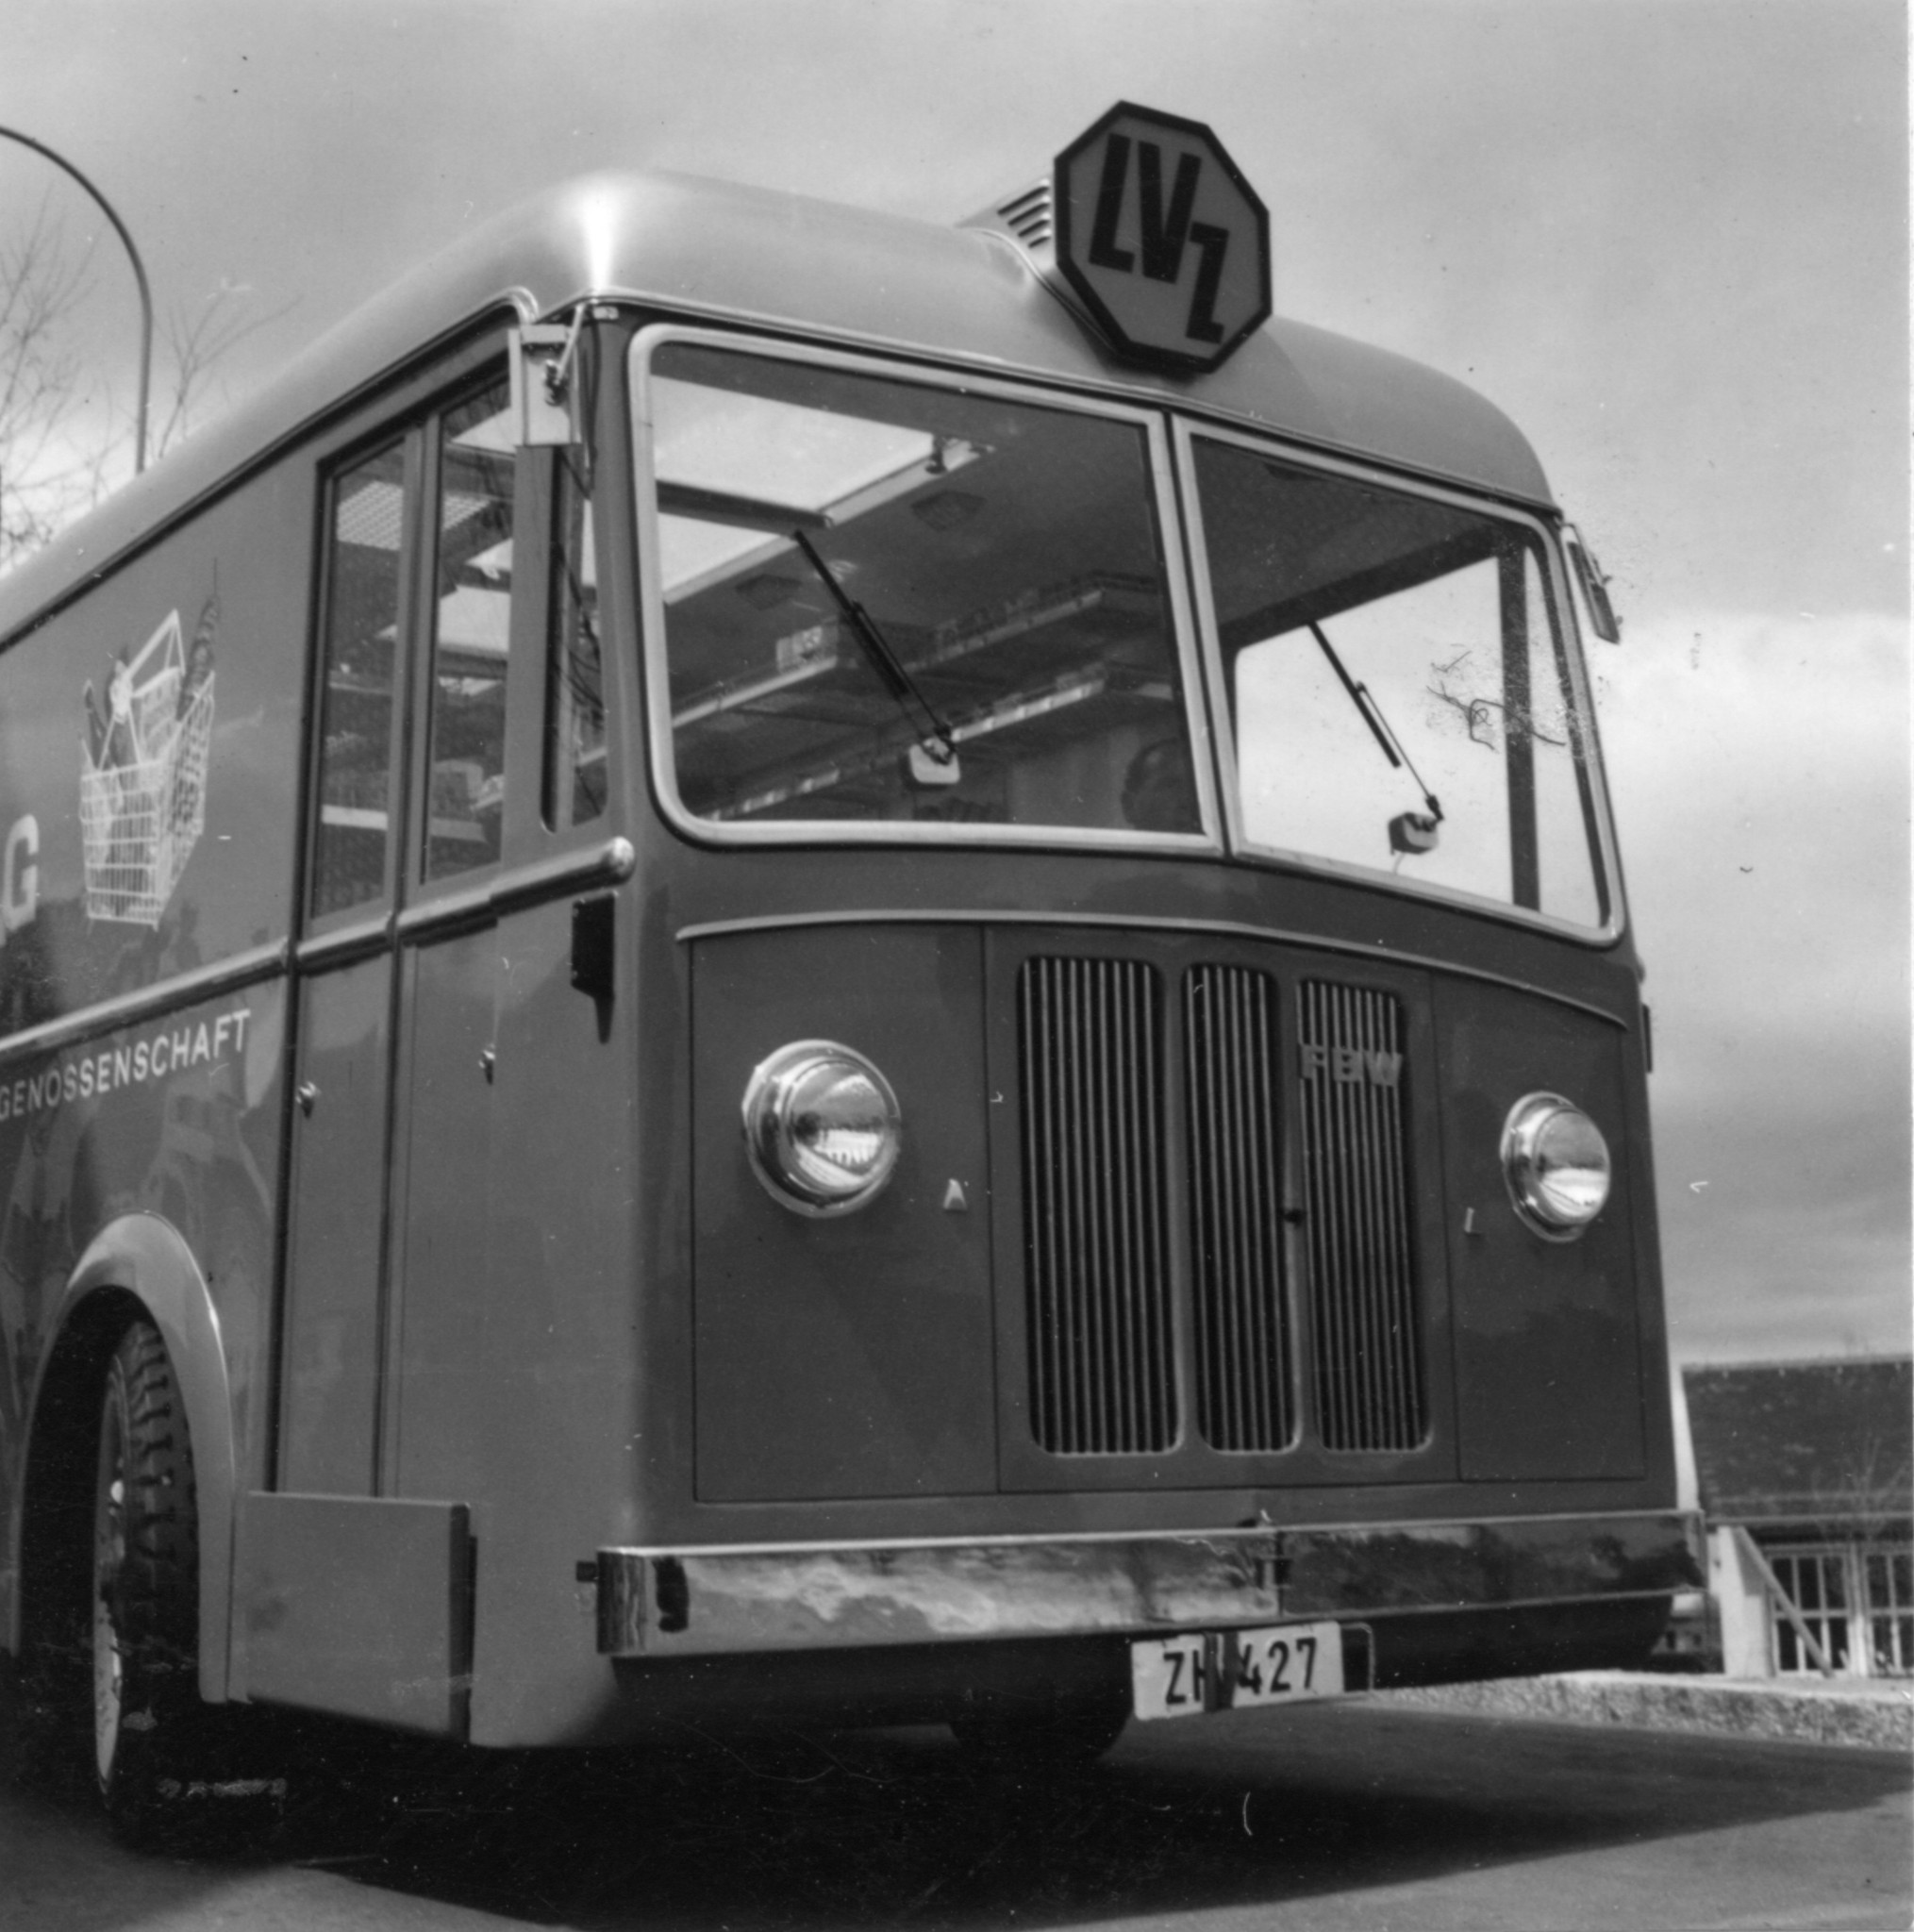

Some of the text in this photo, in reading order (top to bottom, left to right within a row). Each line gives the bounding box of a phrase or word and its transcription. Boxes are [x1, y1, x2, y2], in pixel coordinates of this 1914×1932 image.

[1088, 131, 1230, 345] LVZ
[0, 812, 40, 948] G
[0, 1008, 251, 1122] GENOSSENSCHAFT
[1299, 1043, 1403, 1087] FBW
